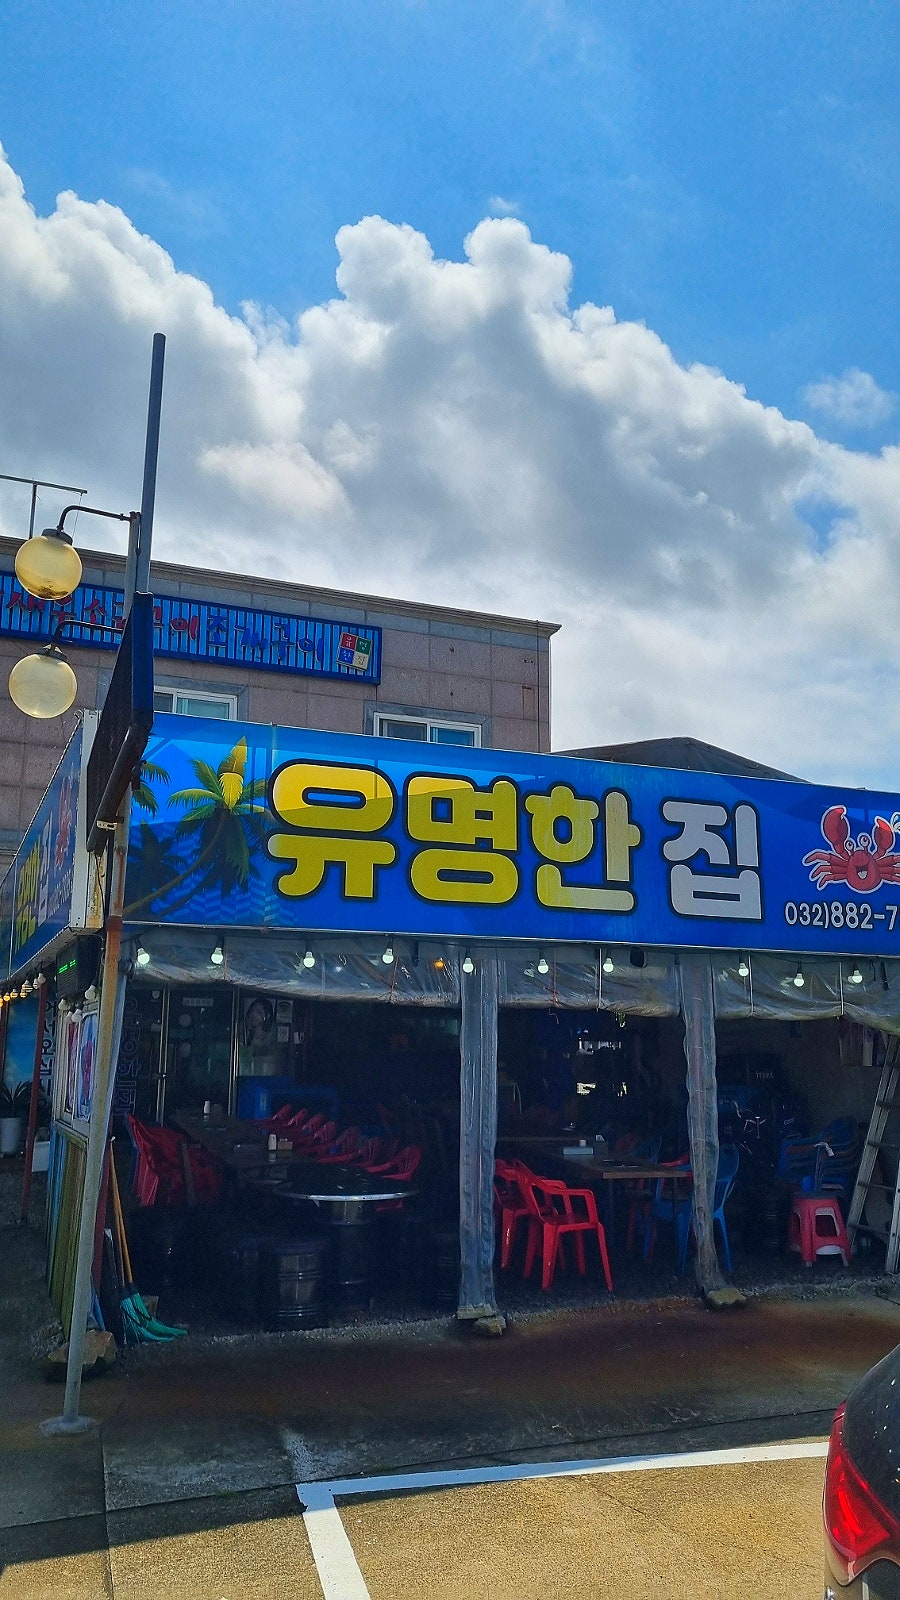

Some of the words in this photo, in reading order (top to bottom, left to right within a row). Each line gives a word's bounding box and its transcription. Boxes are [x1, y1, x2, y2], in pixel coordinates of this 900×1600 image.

[207, 614, 324, 662] 조개구이
[267, 761, 641, 912] 유명한
[661, 798, 763, 920] 집
[784, 901, 899, 930] 032)882-7
